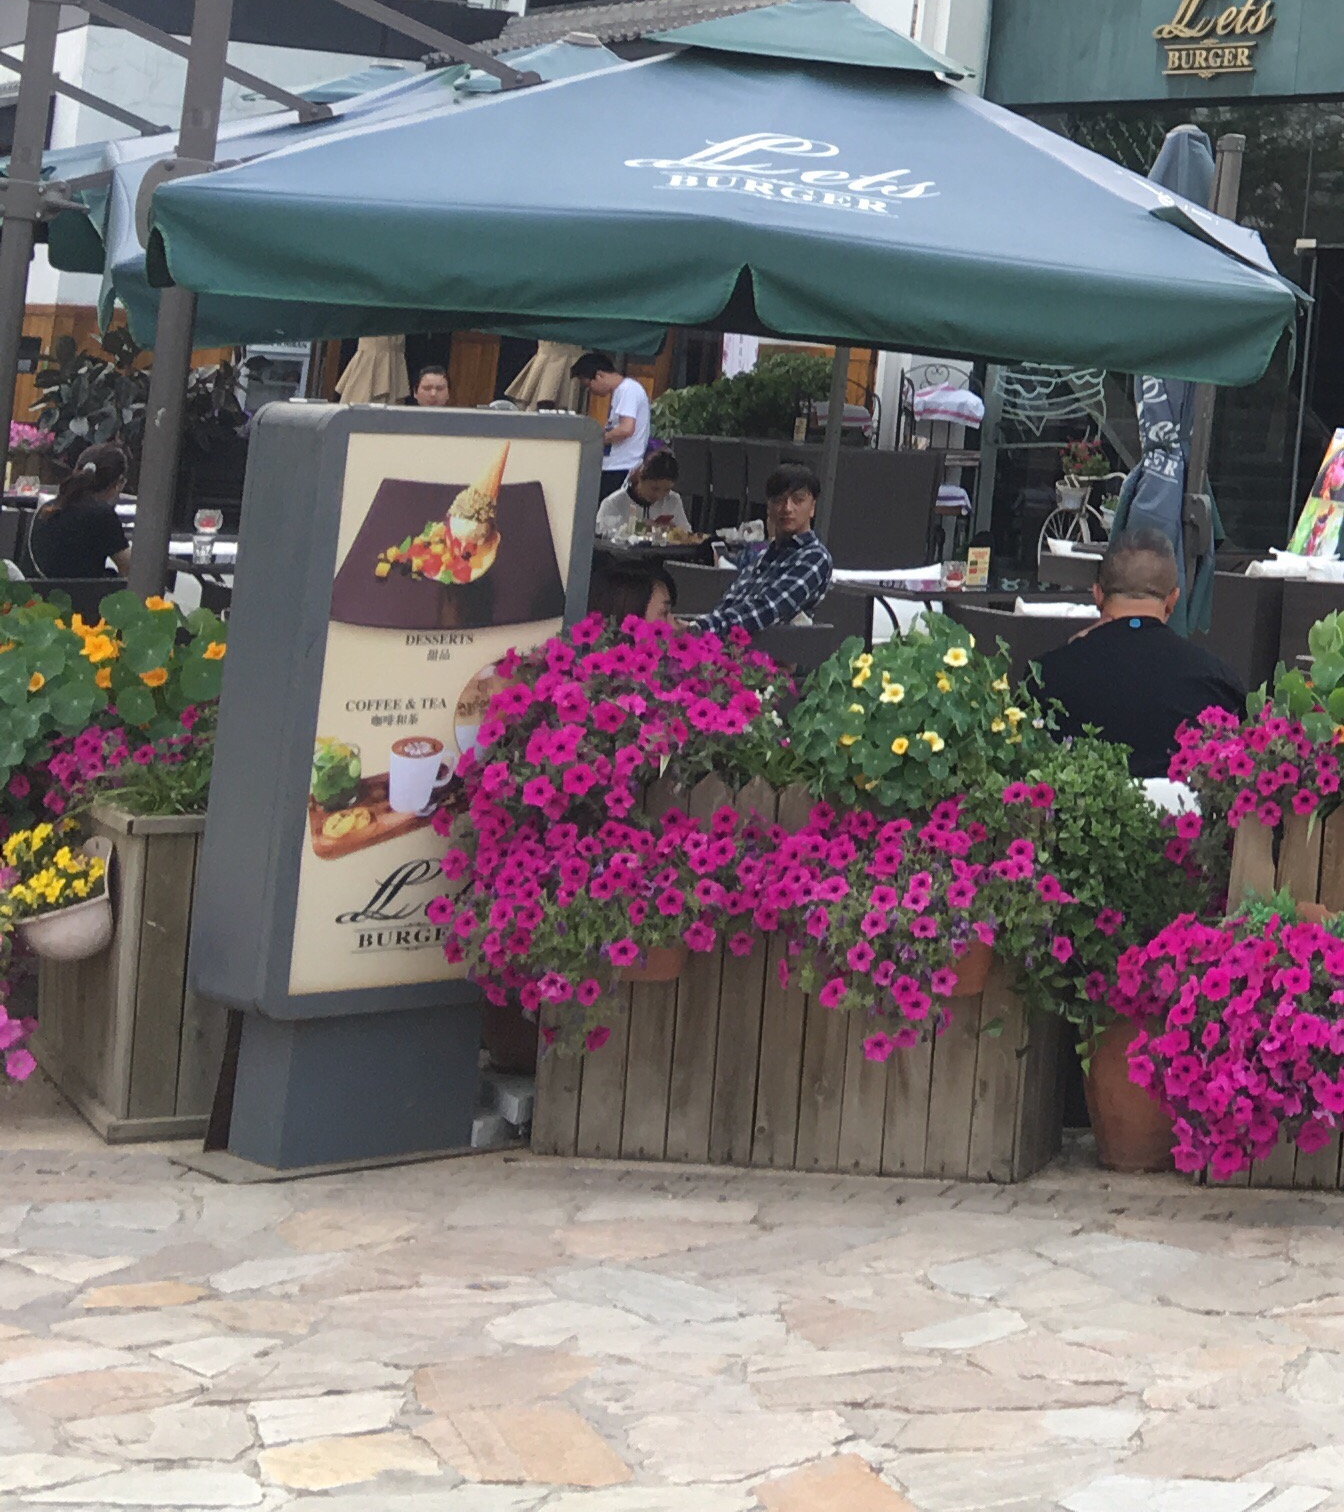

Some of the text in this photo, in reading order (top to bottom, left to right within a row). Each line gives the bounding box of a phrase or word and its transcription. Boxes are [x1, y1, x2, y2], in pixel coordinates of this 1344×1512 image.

[1167, 47, 1252, 69] BURGER
[623, 132, 941, 199] Lets
[668, 174, 889, 214] BURGER
[405, 633, 474, 646] DESSERTS
[426, 648, 451, 661] 甜品
[345, 698, 402, 712] COFFEE
[405, 698, 416, 710] &
[421, 697, 447, 710] TEA
